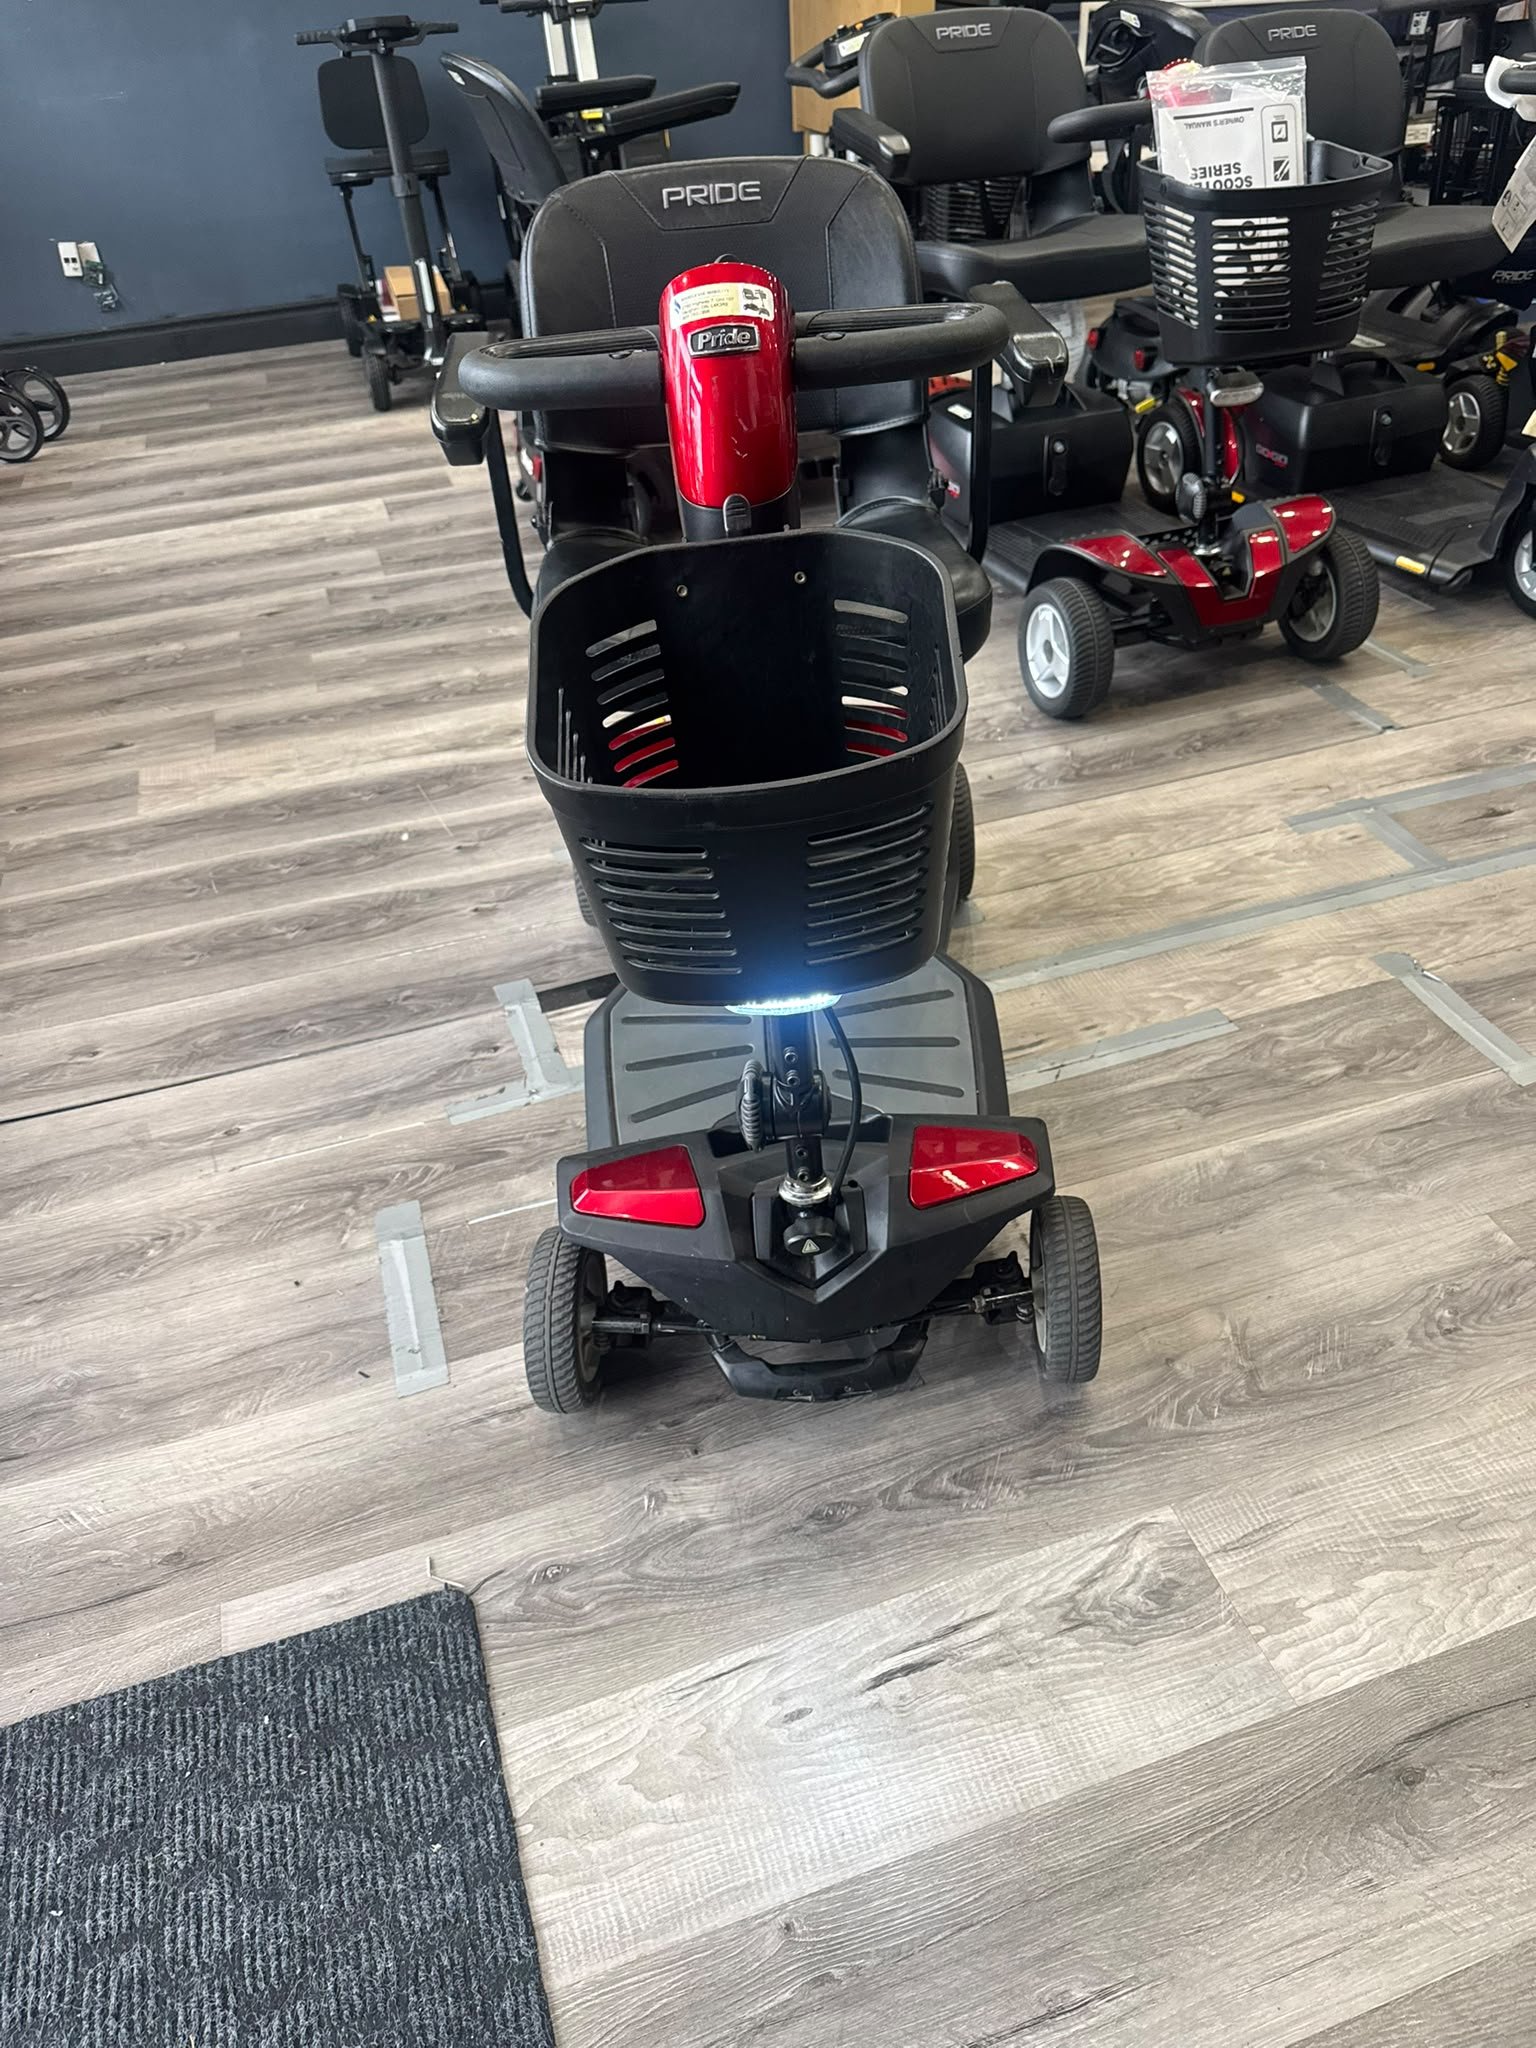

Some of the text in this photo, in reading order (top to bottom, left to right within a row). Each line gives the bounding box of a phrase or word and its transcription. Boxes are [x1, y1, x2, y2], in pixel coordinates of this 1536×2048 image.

[936, 23, 992, 40] PRIDE
[1268, 24, 1318, 42] PRIDE
[1184, 116, 1245, 130] OWNER'S MANUAL
[1190, 162, 1242, 180] SERIES
[662, 180, 762, 209] PRIDE
[697, 327, 751, 350] Pride
